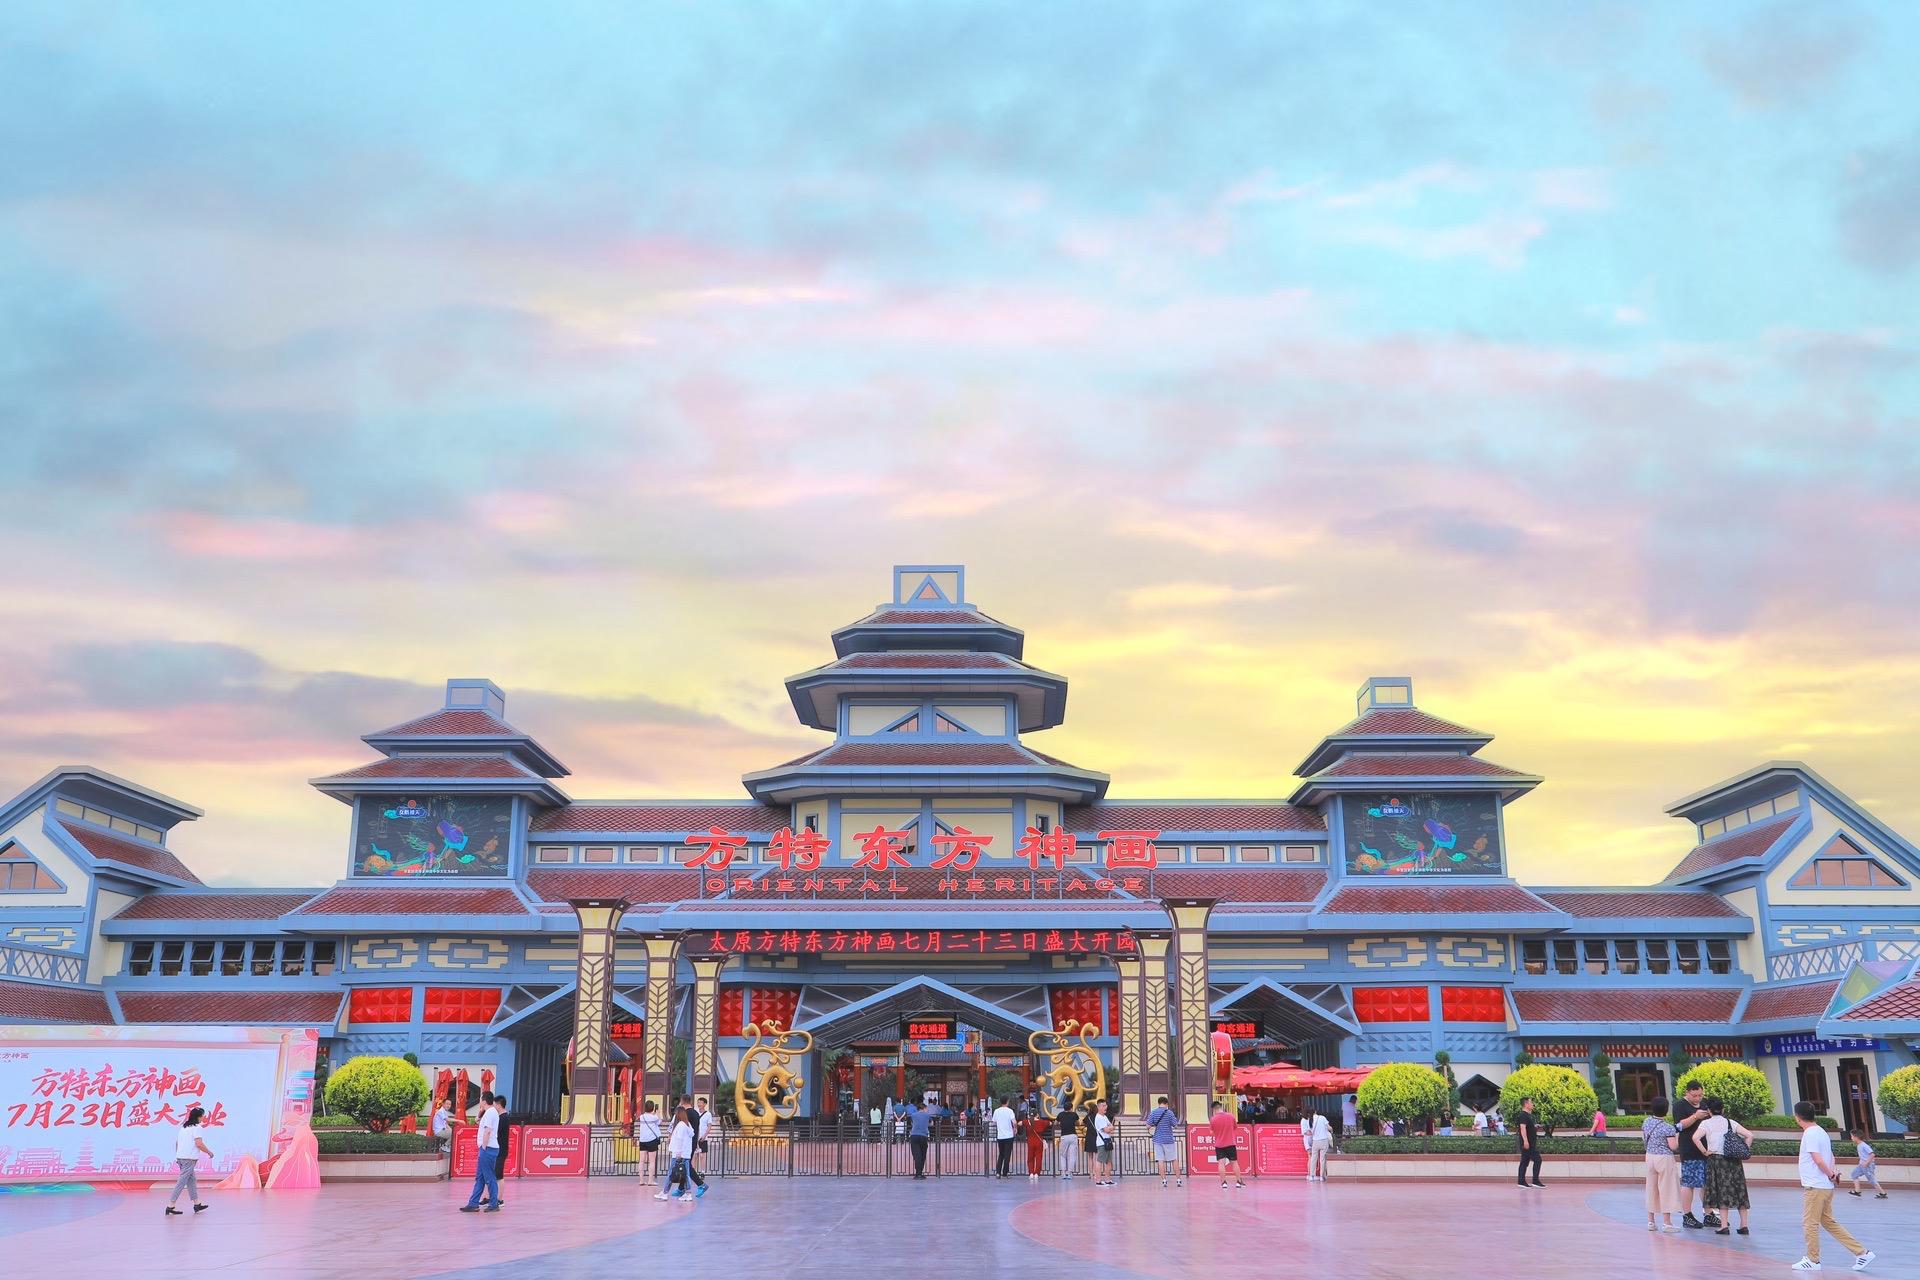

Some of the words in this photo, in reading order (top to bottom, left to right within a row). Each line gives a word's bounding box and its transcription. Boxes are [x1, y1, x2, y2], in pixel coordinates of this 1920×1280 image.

[683, 826, 1161, 871] 方特东方神画
[706, 878, 908, 892] ORIENTAL
[938, 878, 1144, 892] HERITAGE
[708, 930, 1136, 953] 太原方特东方神画七月二十三日盛大开园
[31, 1063, 206, 1101] 方特东方神画
[532, 1137, 579, 1146] 团体安检入口
